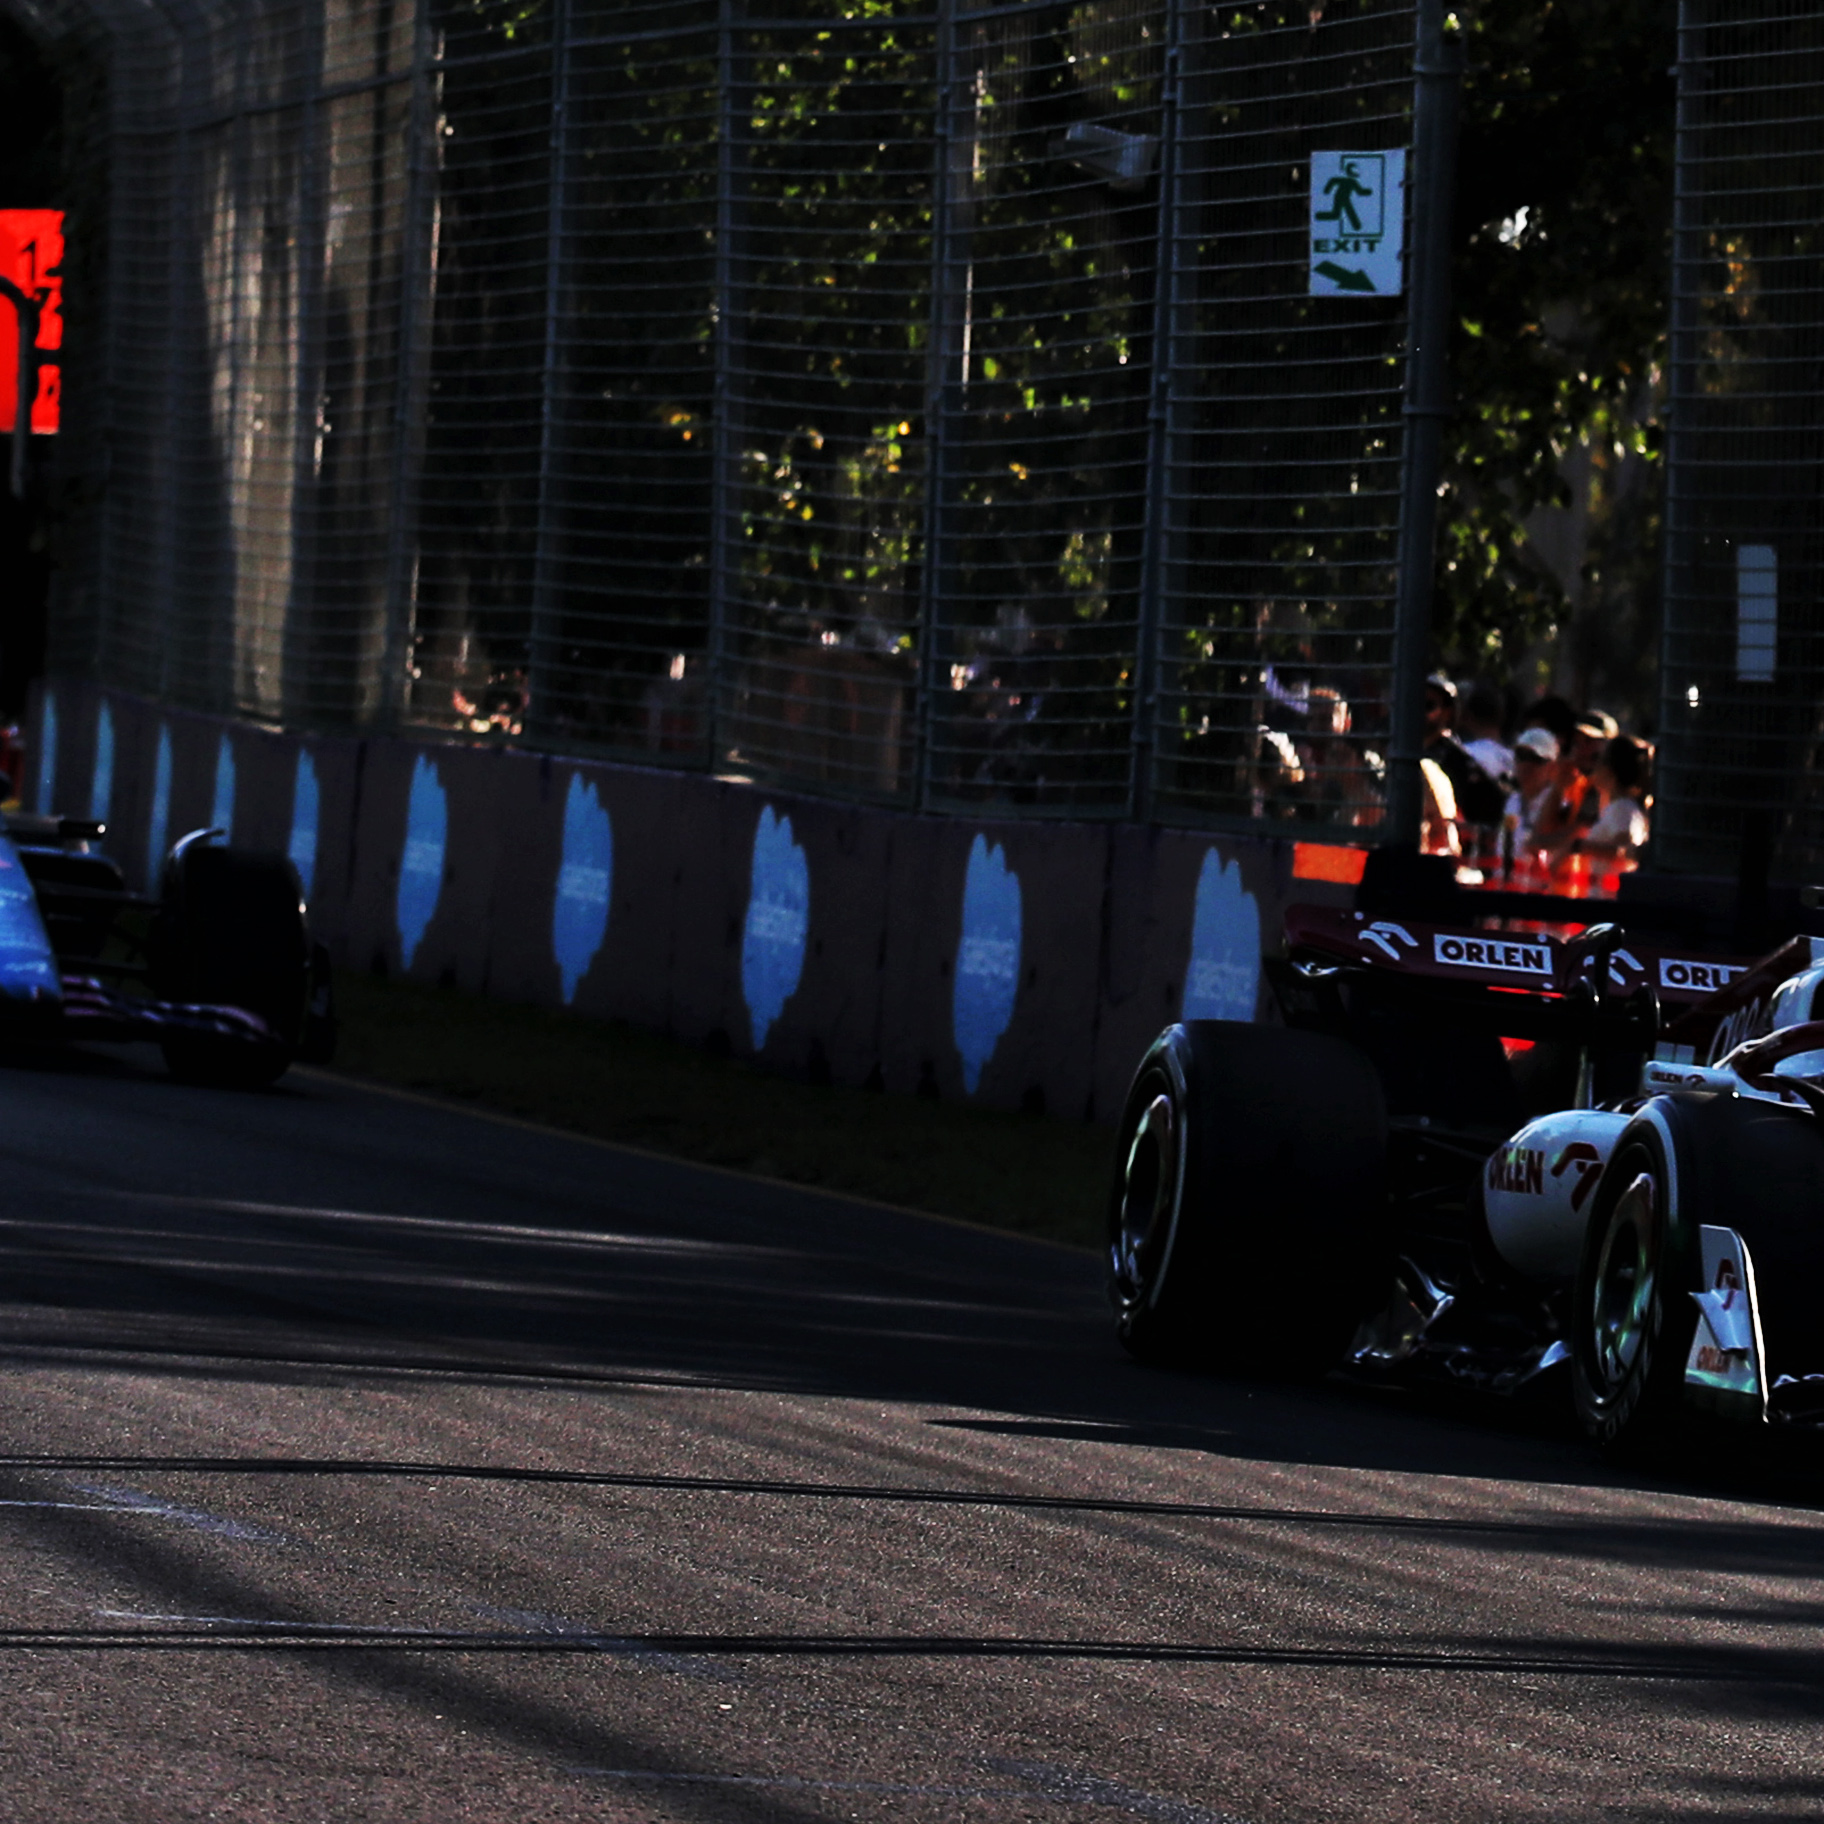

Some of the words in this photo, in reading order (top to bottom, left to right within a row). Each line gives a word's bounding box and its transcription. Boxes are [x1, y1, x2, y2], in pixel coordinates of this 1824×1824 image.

[1313, 239, 1381, 253] EXIT
[1440, 939, 1544, 972] ORLEN
[1666, 964, 1747, 988] ORL
